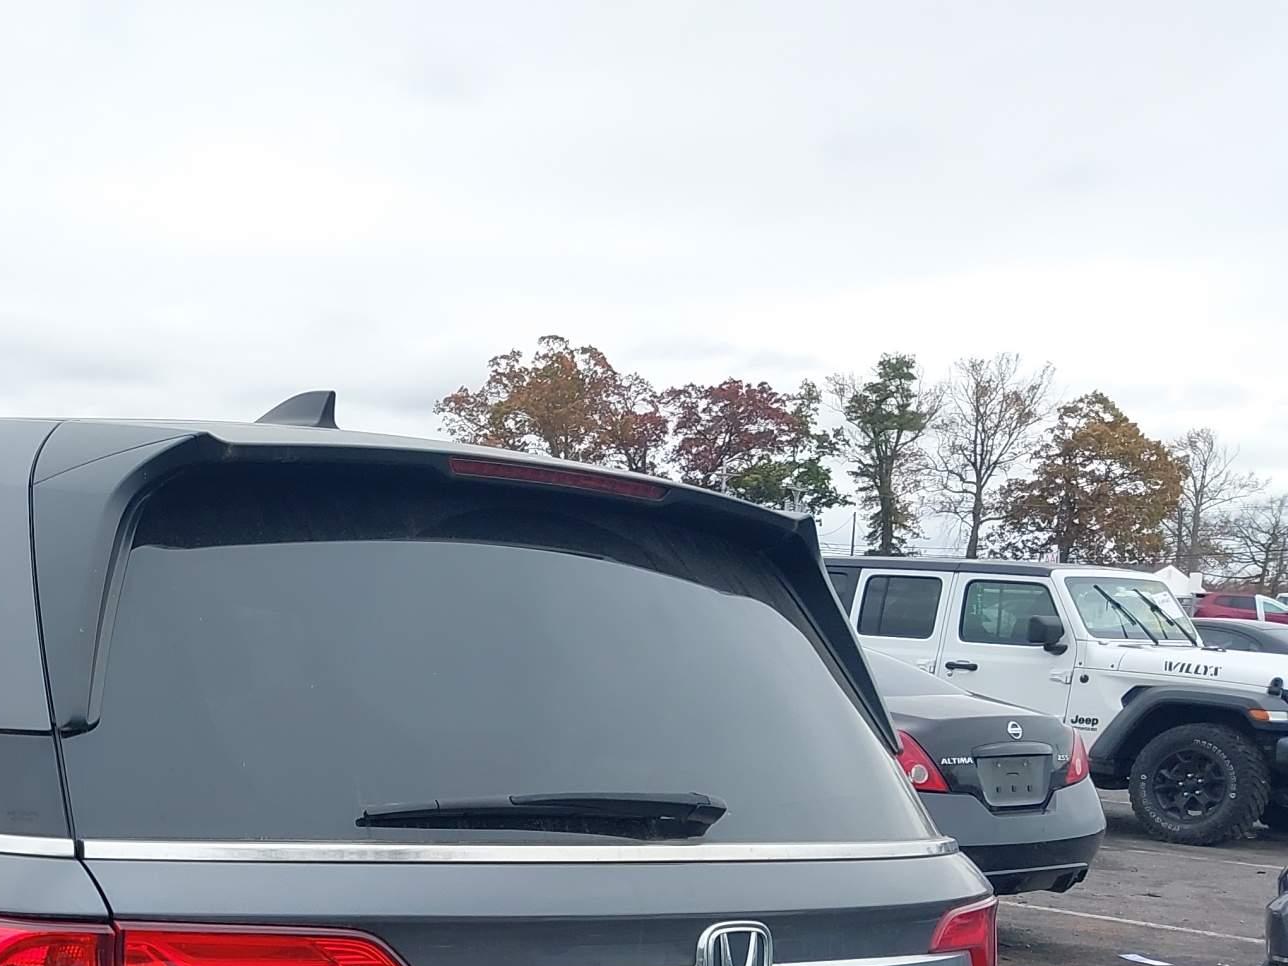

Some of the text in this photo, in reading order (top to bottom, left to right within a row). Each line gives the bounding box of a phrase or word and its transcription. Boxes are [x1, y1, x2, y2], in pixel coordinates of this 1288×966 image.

[1164, 661, 1221, 676] WILLYS
[1070, 715, 1099, 726] Jeep
[940, 757, 974, 765] ALTIMA
